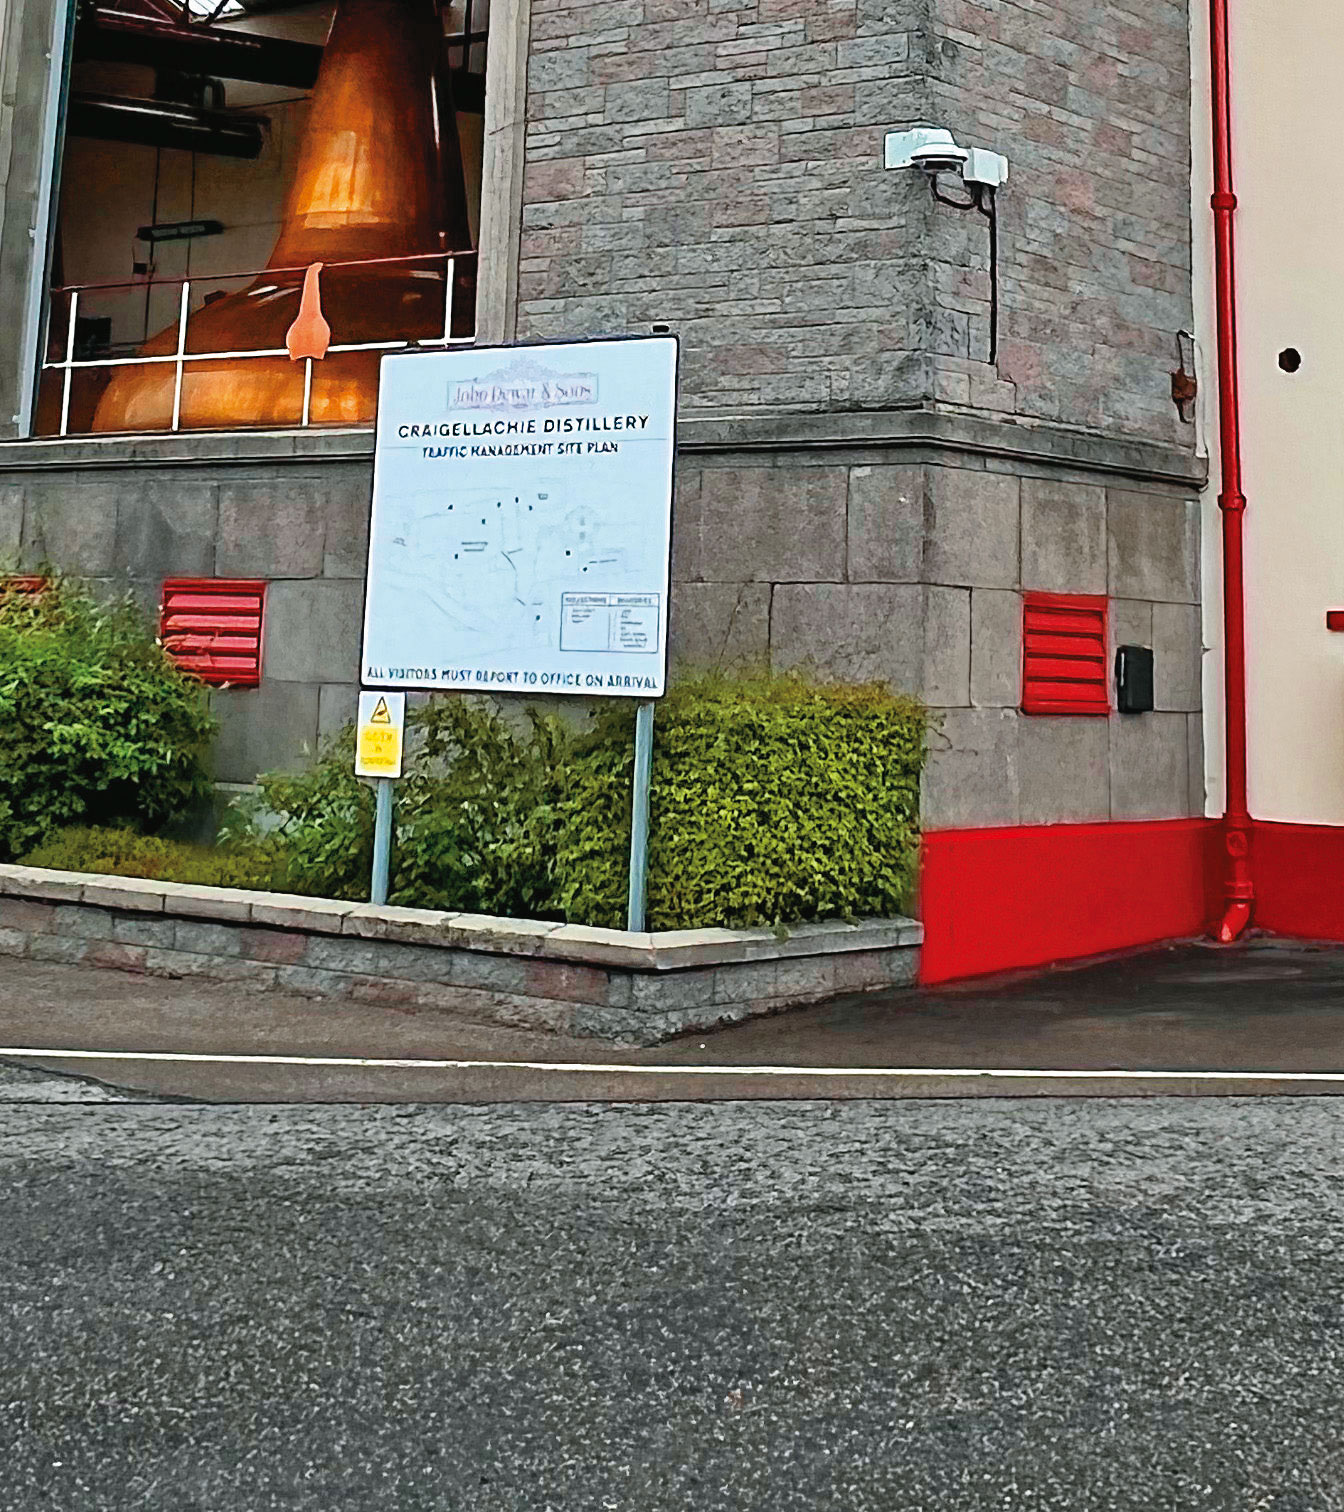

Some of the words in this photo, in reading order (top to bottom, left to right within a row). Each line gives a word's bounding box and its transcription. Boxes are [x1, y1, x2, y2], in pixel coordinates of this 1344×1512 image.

[398, 419, 536, 438] CRAIGELLACHIE
[543, 415, 649, 434] DISTILLERY
[470, 443, 555, 458] MANAGEMENT
[557, 441, 584, 456] SITE
[587, 440, 619, 455] PLAN
[388, 668, 437, 681] VISITORS
[441, 669, 472, 682] MUST
[523, 672, 537, 685] TO
[540, 672, 582, 687] OFFICE
[585, 674, 604, 688] ON
[607, 674, 659, 689] ARRIVAL
